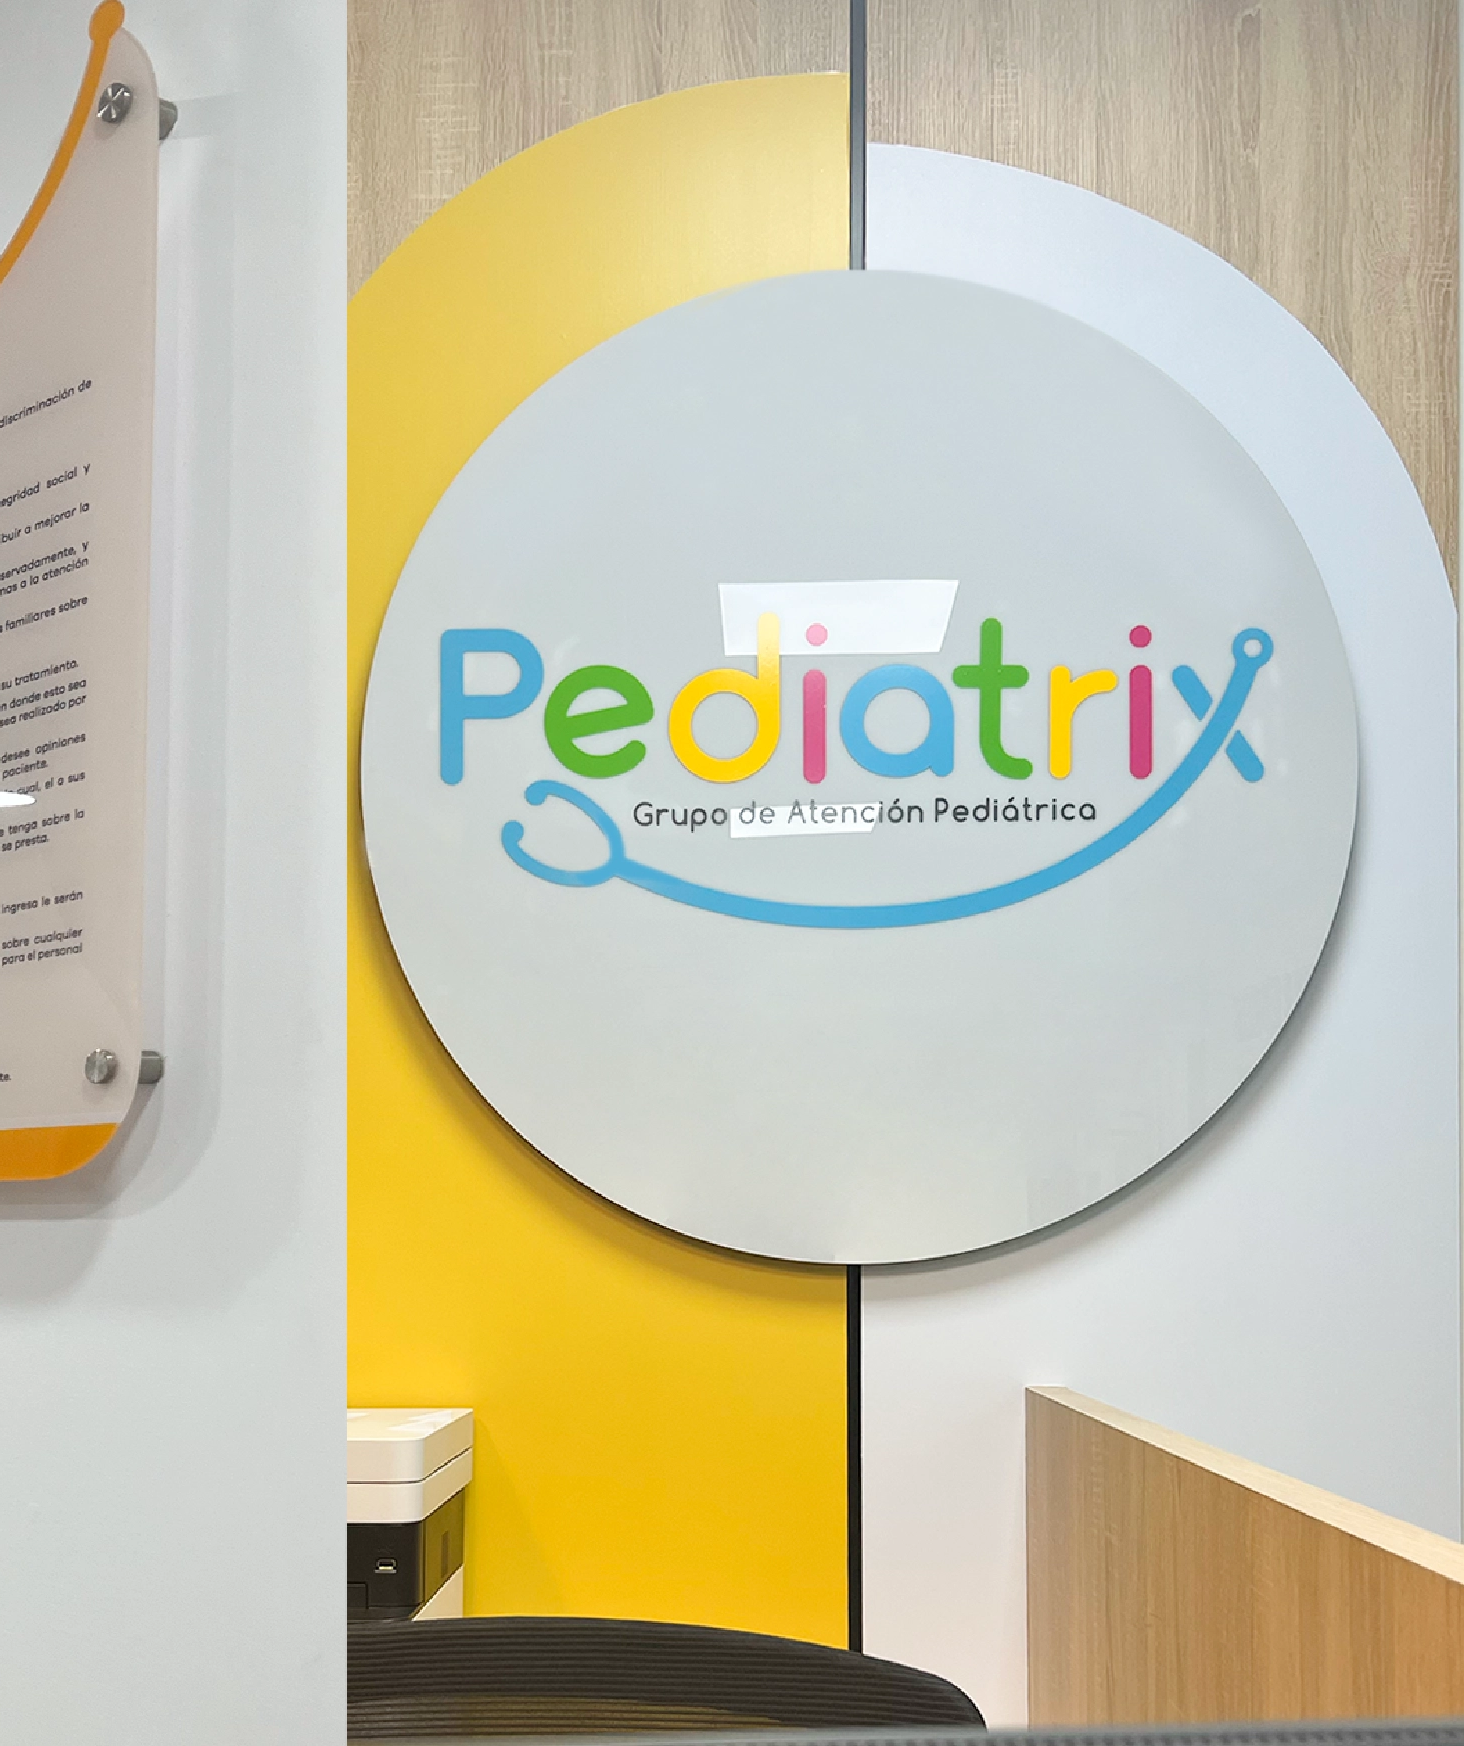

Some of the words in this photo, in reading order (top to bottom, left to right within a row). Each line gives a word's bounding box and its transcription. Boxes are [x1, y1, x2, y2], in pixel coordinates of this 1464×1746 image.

[0, 388, 75, 429] discriminación
[78, 380, 92, 393] de
[47, 467, 78, 490] social
[83, 464, 91, 476] y
[82, 541, 90, 553] y
[439, 611, 1274, 786] Pediatrix
[0, 749, 31, 764] desee
[35, 734, 87, 755] opiniones
[633, 801, 729, 833] Grupo
[738, 800, 775, 827] de
[786, 798, 925, 826] Atención
[933, 795, 1098, 823] Pediátrica
[2, 900, 39, 915] ingreso
[42, 896, 51, 907] le
[54, 891, 84, 905] serán
